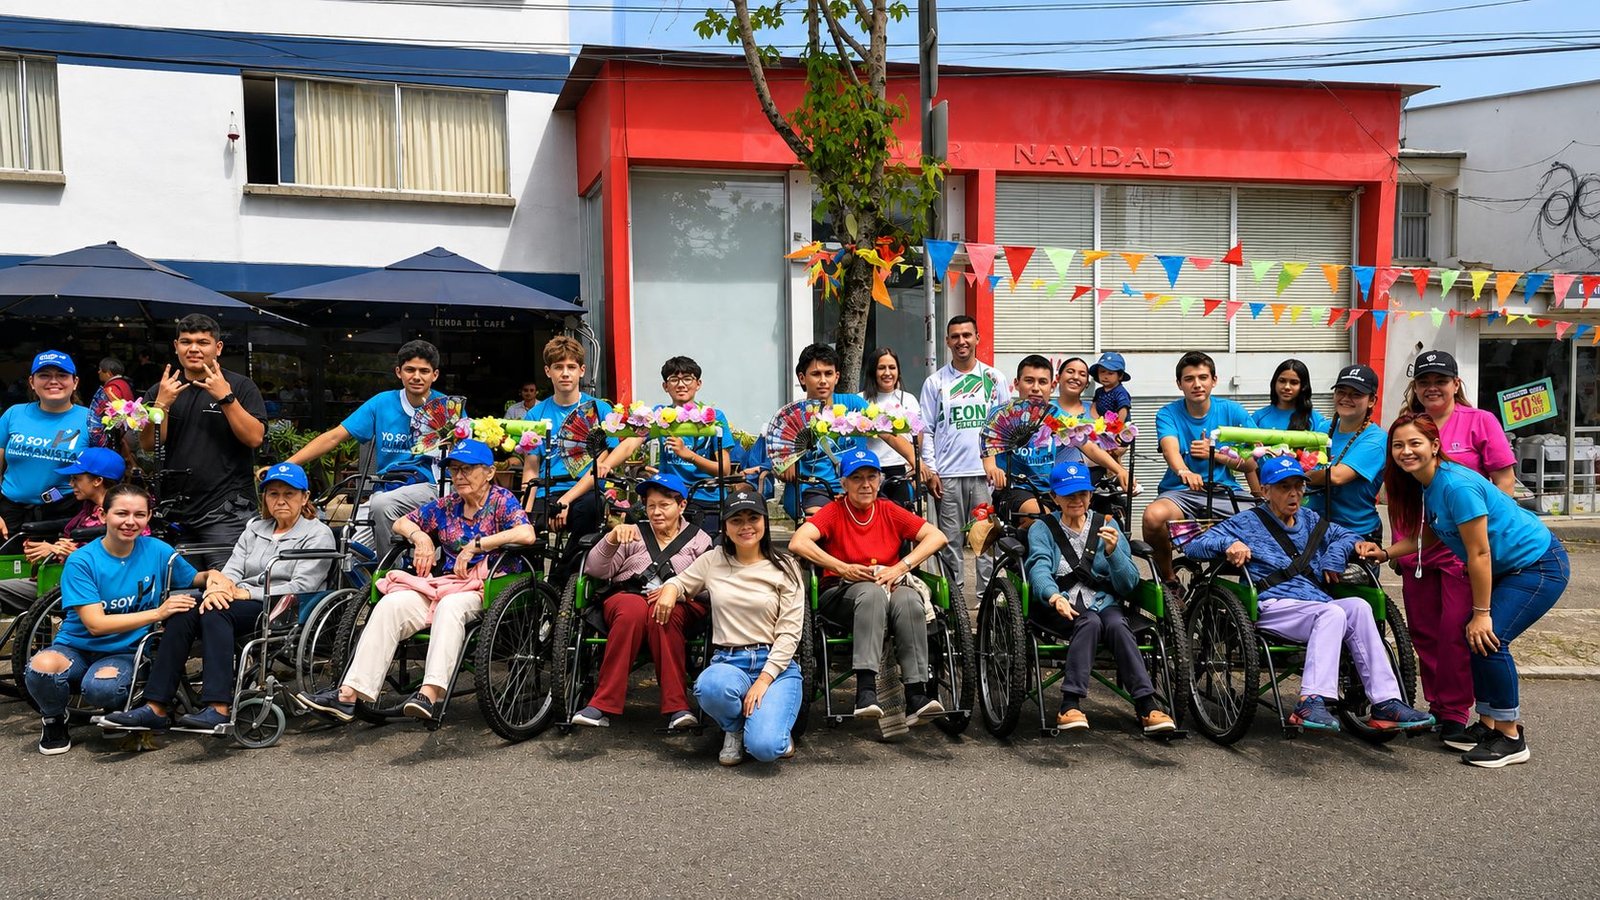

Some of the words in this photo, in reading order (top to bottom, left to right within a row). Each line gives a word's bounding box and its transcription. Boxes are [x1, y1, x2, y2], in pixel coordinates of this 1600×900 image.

[1015, 143, 1175, 169] NAVIDAD
[429, 319, 462, 327] TIENDA
[26, 435, 51, 448] SOY
[382, 432, 394, 442] YO
[111, 595, 135, 610] SOY
